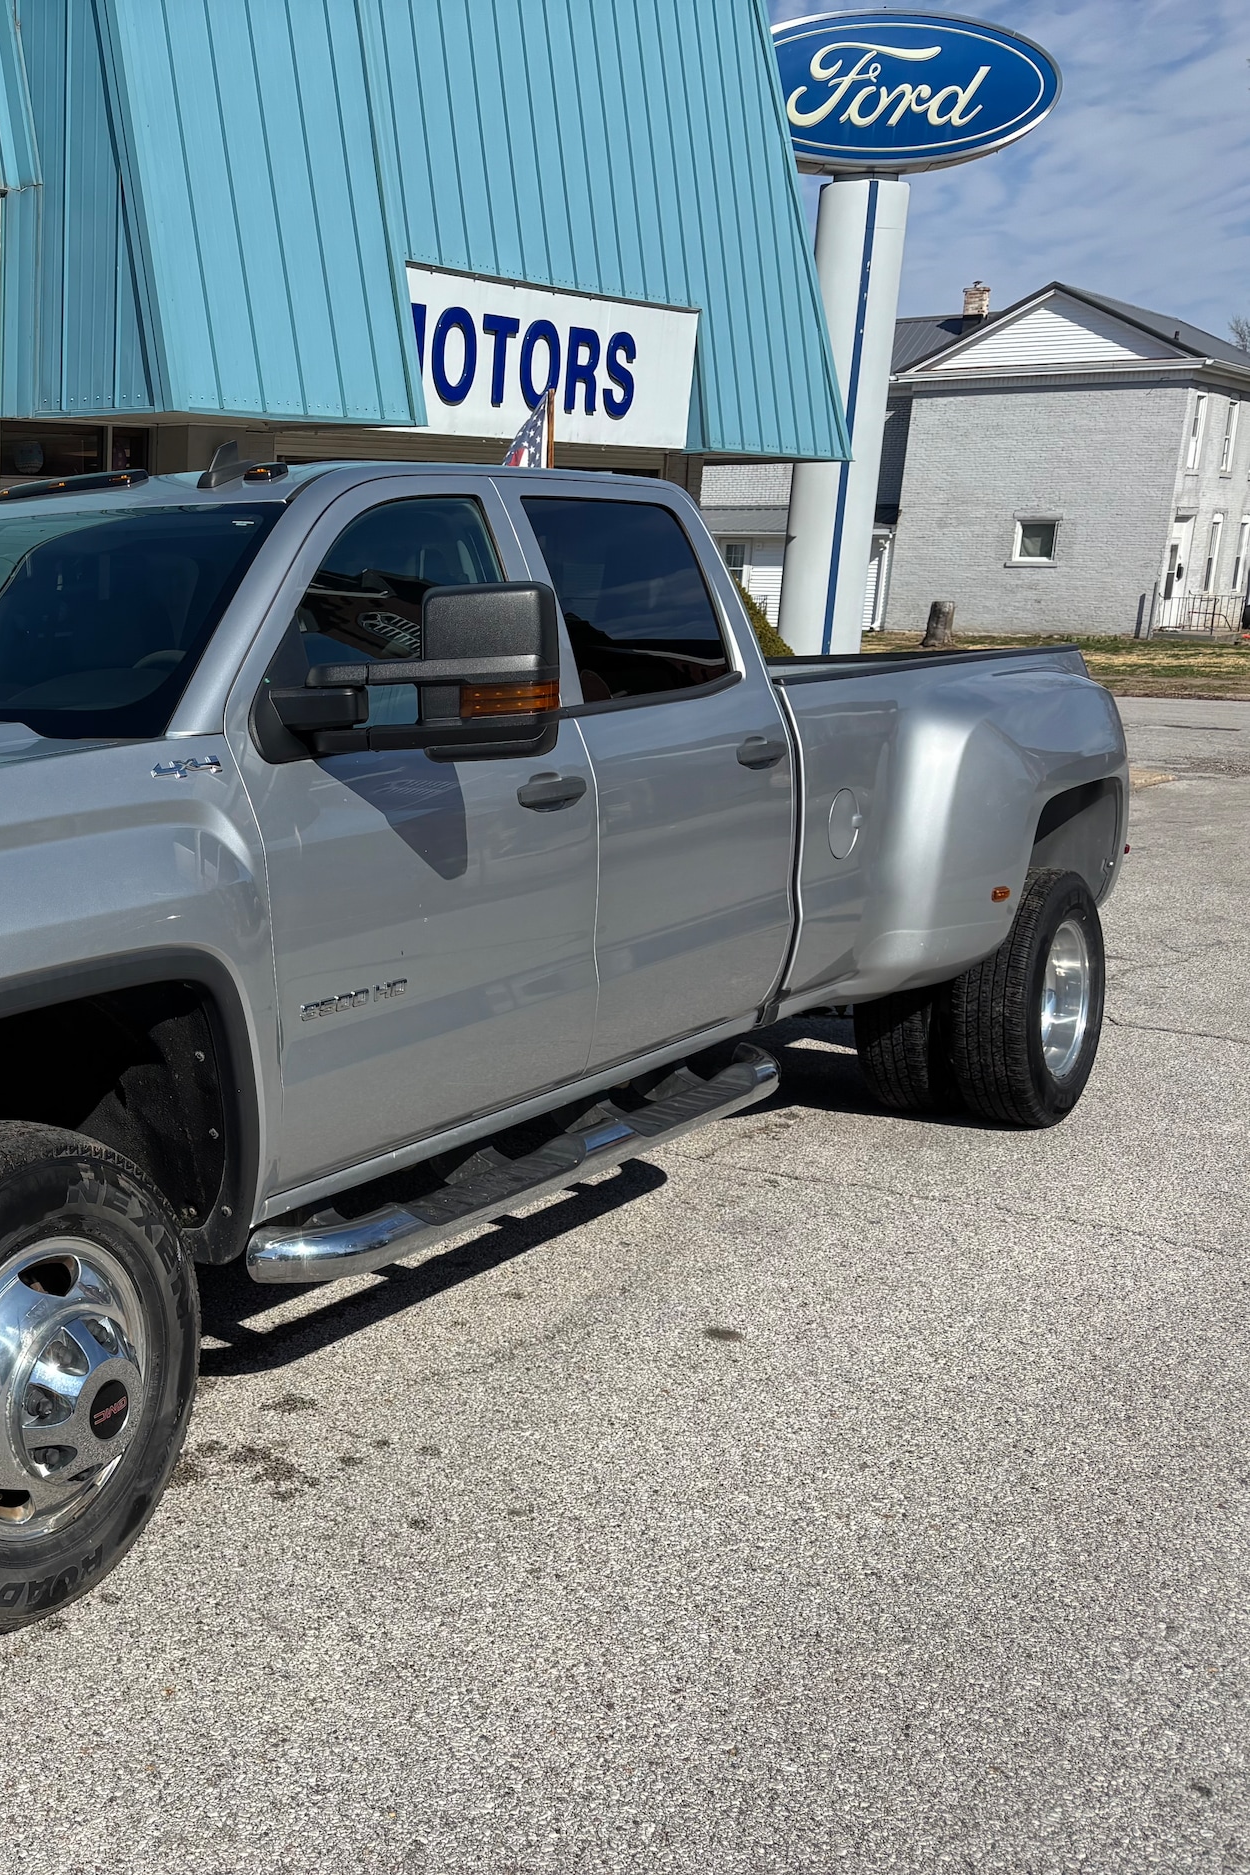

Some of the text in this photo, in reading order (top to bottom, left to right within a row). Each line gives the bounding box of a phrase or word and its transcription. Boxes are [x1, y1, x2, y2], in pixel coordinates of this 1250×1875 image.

[786, 42, 991, 128] Ford
[300, 978, 408, 1022] 3500 HD
[93, 1396, 128, 1426] GMC
